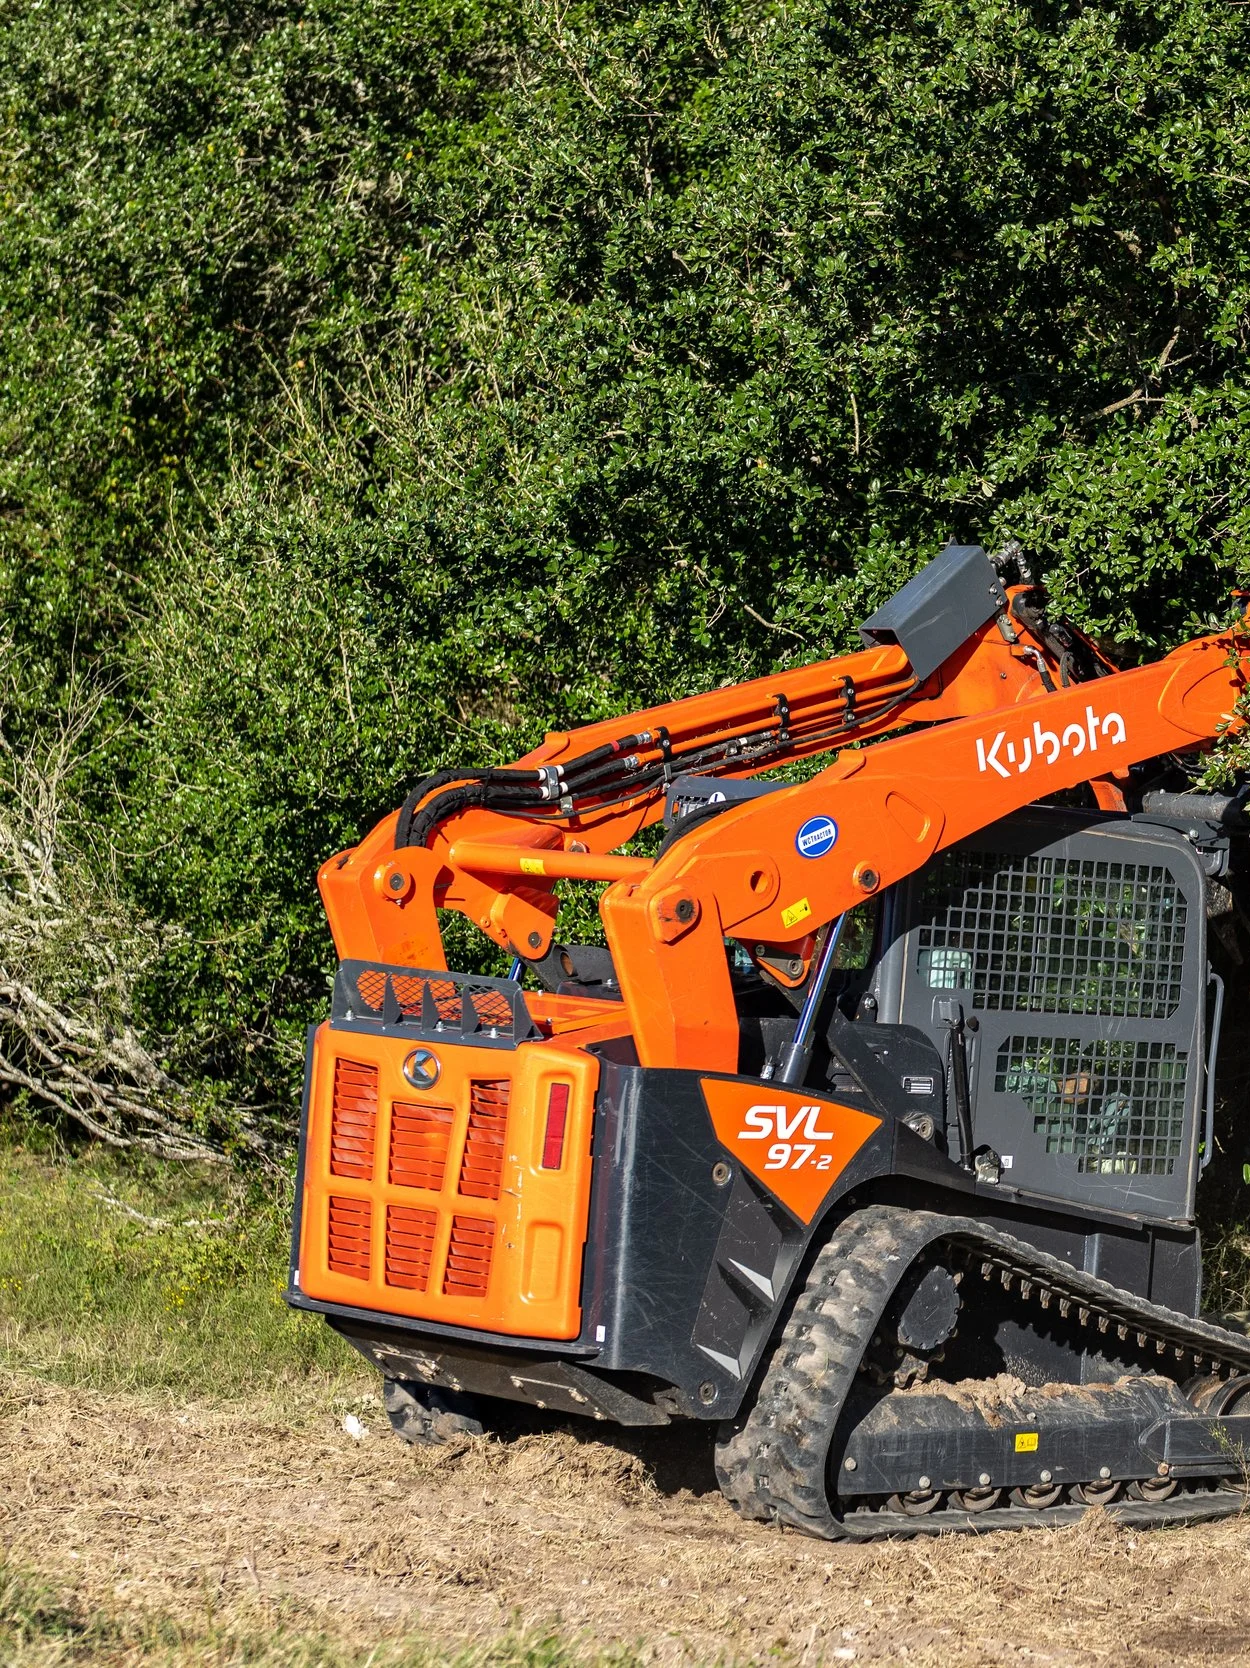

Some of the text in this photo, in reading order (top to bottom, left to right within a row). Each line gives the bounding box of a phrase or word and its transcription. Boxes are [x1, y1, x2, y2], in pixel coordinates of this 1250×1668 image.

[975, 705, 1127, 778] Kubota
[737, 1105, 834, 1140] SVL
[763, 1143, 833, 1170] 97-2
